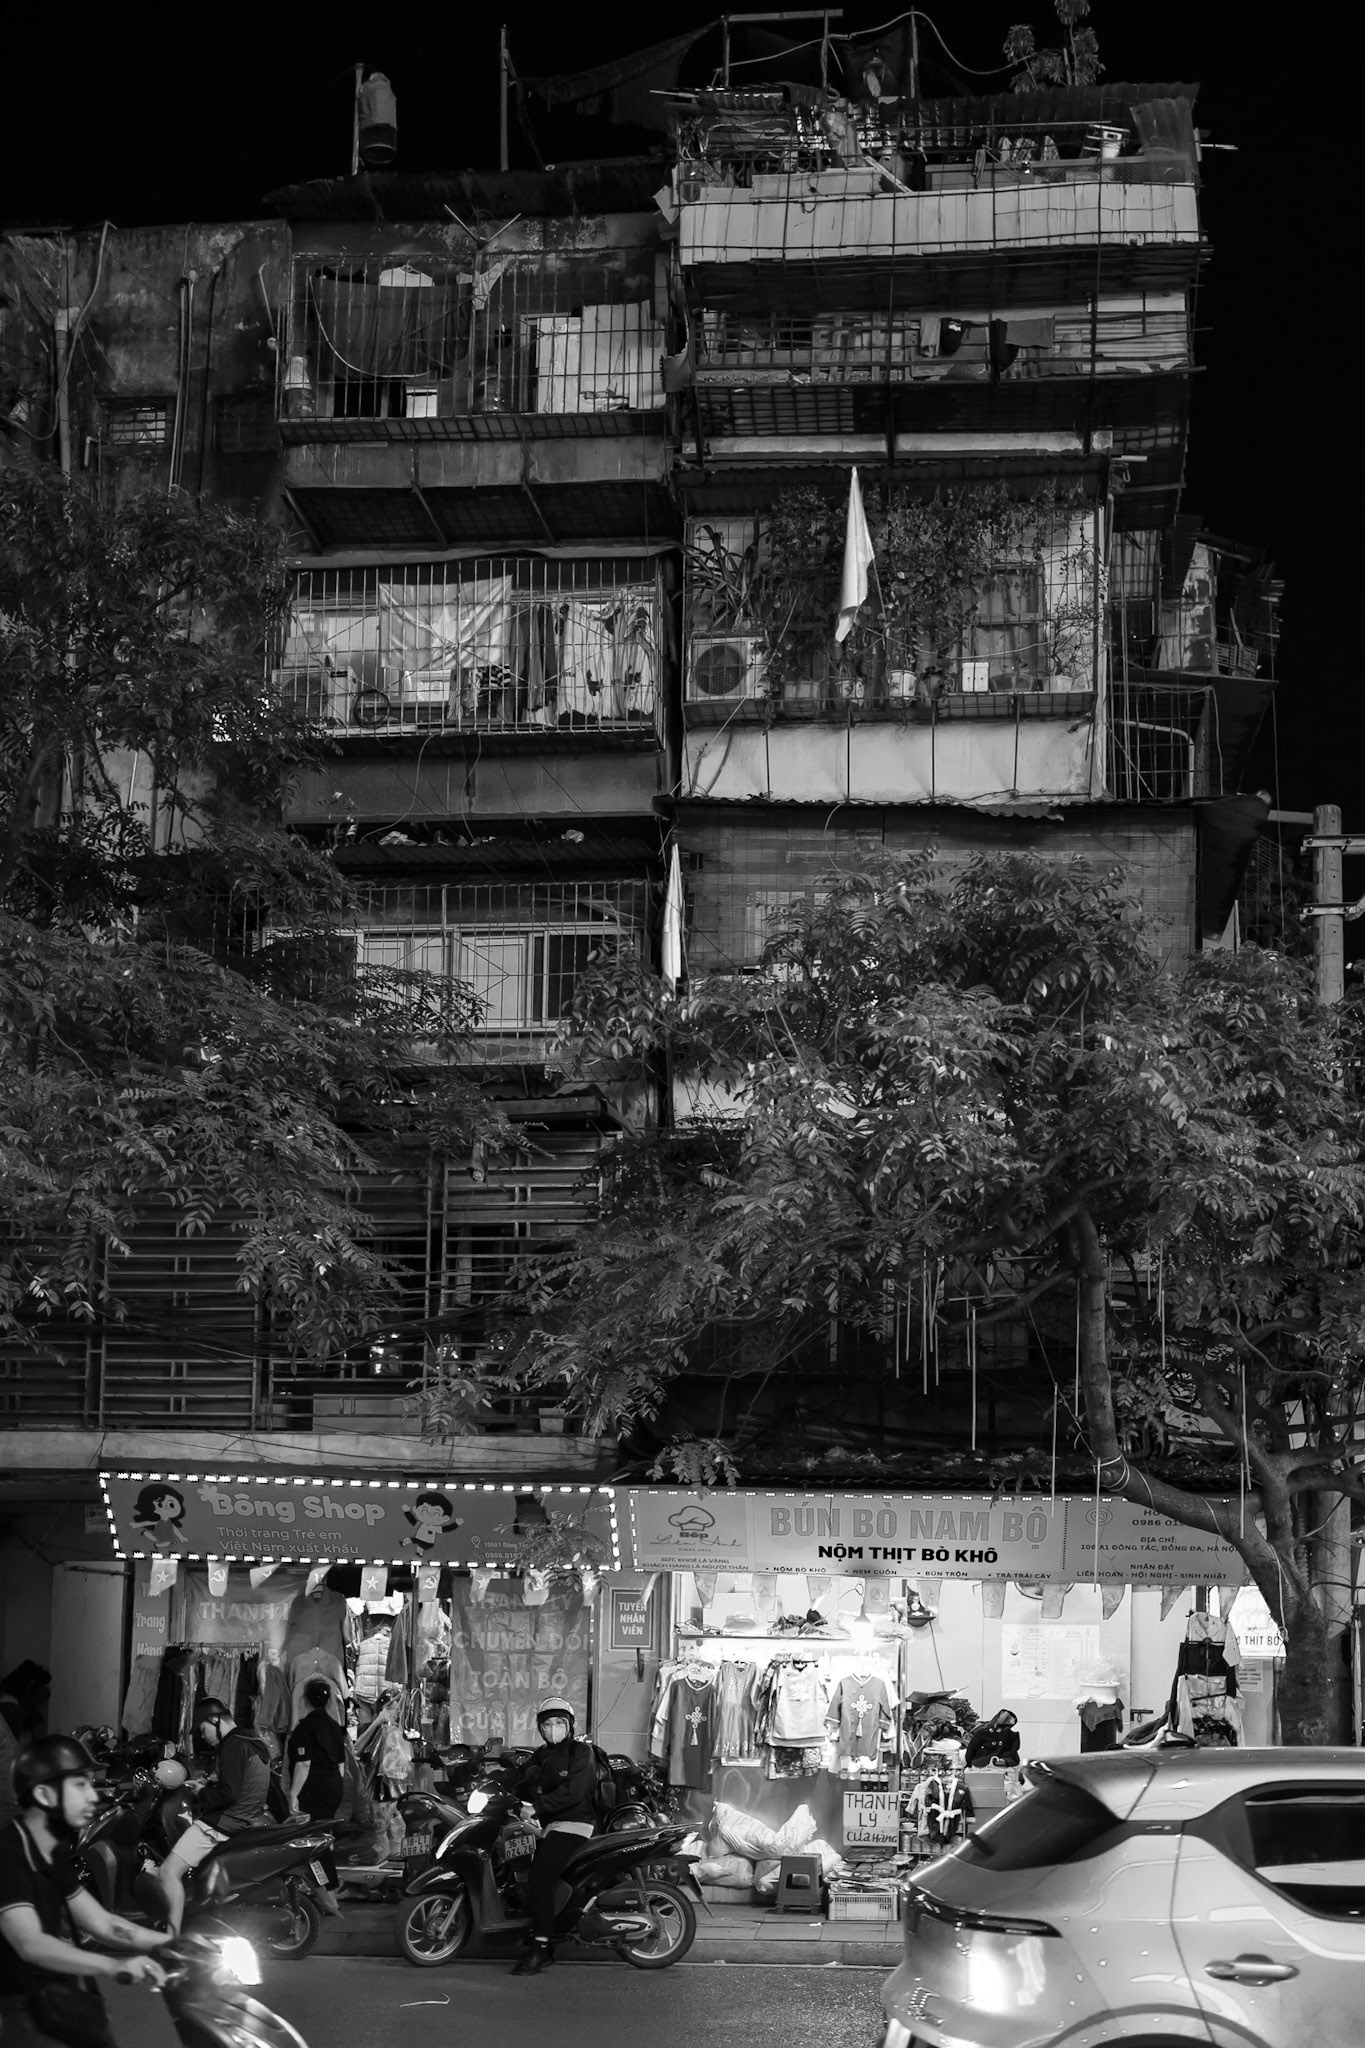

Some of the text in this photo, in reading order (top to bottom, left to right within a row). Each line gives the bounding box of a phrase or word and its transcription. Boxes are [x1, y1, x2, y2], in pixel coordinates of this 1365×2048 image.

[303, 1495, 386, 1526] Shop
[770, 1501, 1048, 1550] BÚN BÒ NAM BỘ
[217, 1526, 342, 1541] Thời trang Trẻ em
[219, 1540, 359, 1554] Việt Nam xuất khẩu
[818, 1543, 998, 1564] NỘM THỊT BÒ KHÔ
[1111, 1543, 1138, 1551] ĐÔNG
[1130, 1562, 1156, 1571] NHẬN
[1131, 1571, 1147, 1579] HỘI
[1203, 1572, 1228, 1581] NHẬT
[136, 1612, 165, 1634] Trang
[620, 1612, 645, 1624] NHÂN
[622, 1624, 643, 1635] VIÊN
[471, 1665, 569, 1695] TOÀN BỘ
[859, 1810, 878, 1828] LÝ
